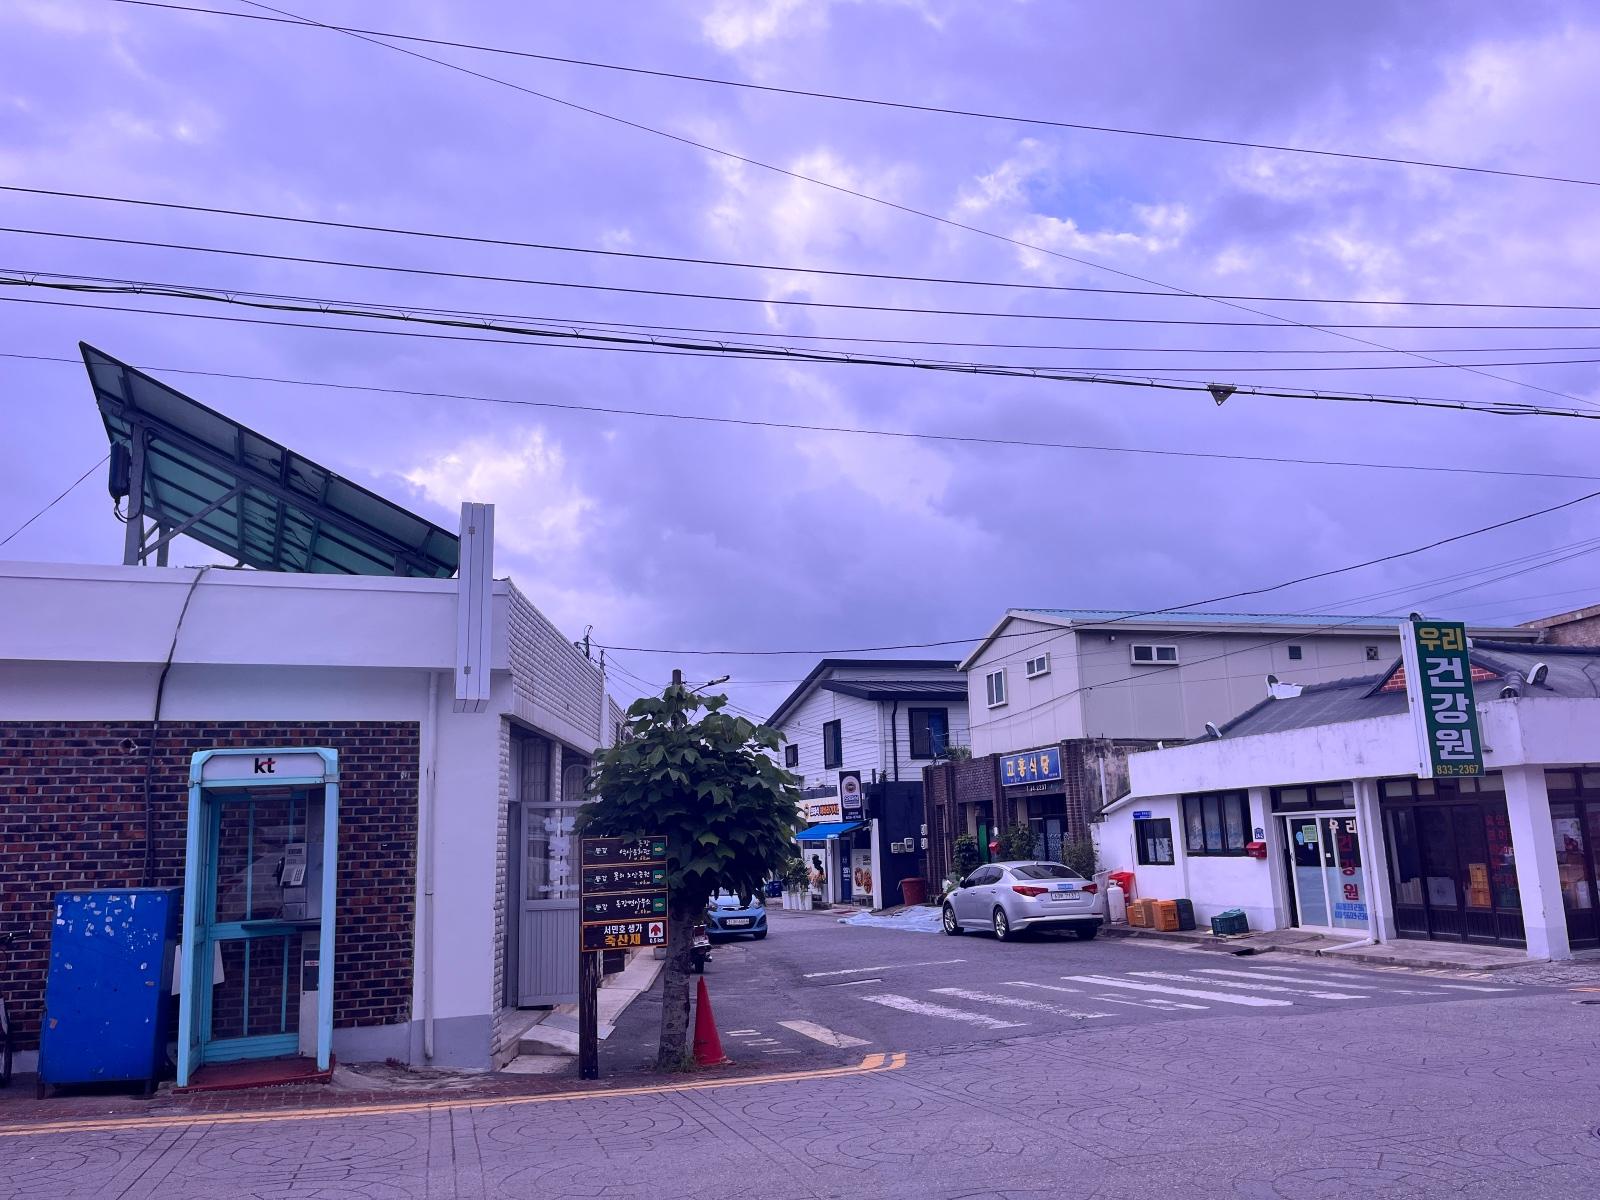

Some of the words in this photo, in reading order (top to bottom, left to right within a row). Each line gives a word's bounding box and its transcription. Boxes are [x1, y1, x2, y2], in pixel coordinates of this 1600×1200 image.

[1419, 627, 1464, 651] 우리
[1425, 657, 1475, 760] 건강원
[254, 757, 276, 774] kt
[1436, 764, 1480, 775] 833-2367
[603, 925, 626, 935] 서민호
[628, 923, 643, 933] 생가
[604, 933, 641, 947] 죽산재
